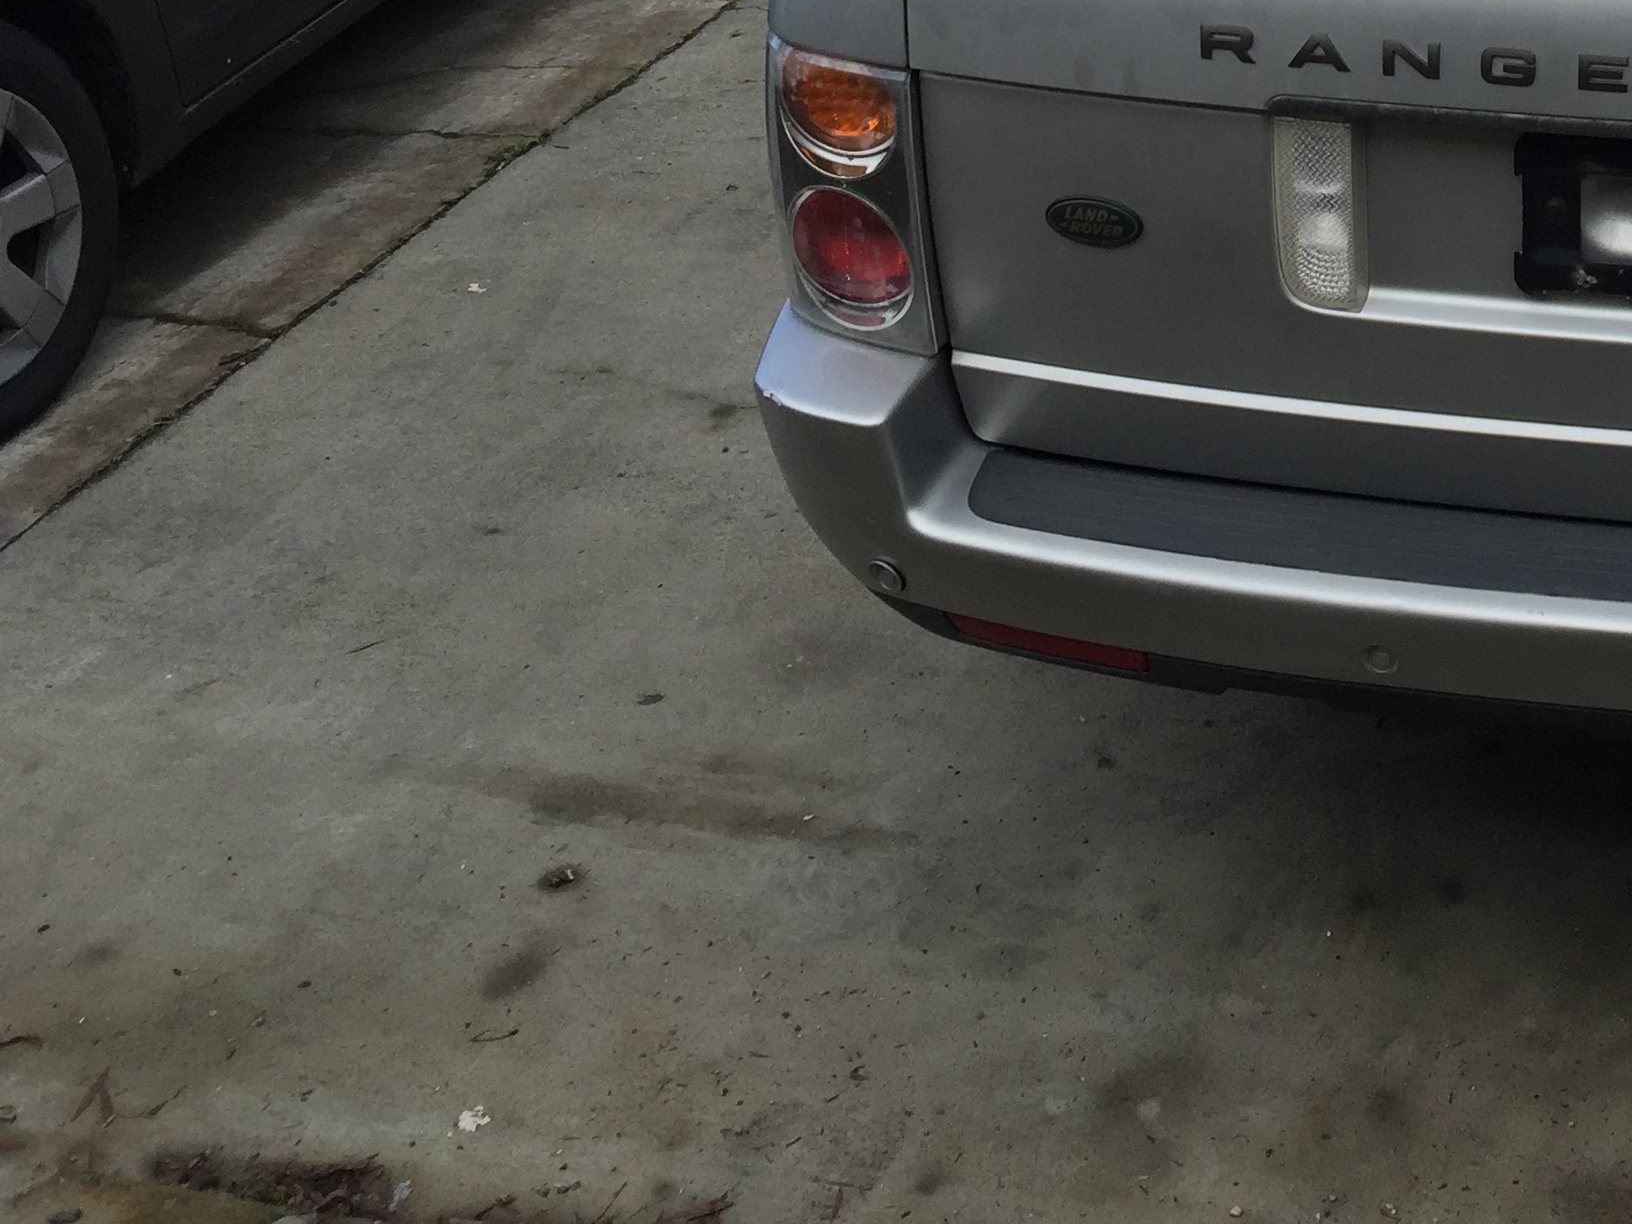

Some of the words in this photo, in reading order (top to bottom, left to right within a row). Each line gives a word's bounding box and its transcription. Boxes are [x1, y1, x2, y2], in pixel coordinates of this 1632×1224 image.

[1198, 24, 1630, 94] RANGE
[1064, 206, 1108, 222] LAND
[1070, 221, 1124, 237] ROVER
